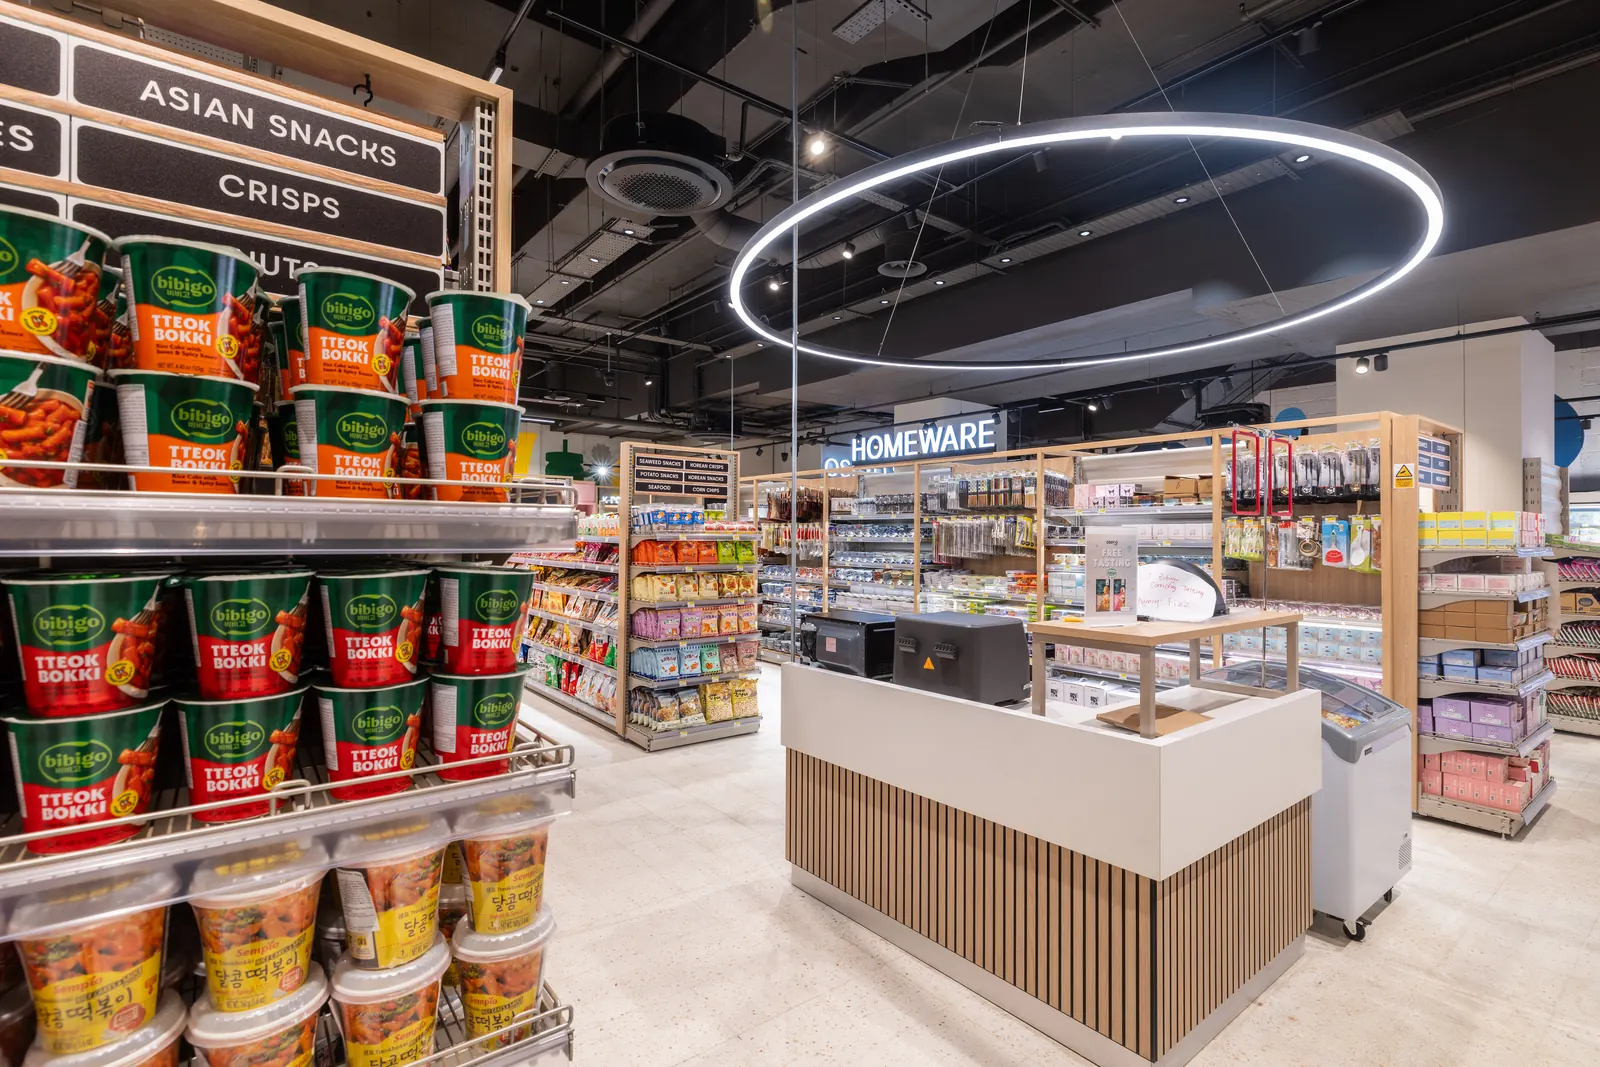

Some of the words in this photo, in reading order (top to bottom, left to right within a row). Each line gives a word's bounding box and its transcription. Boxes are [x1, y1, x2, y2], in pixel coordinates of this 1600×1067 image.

[140, 80, 254, 130] ASIAN
[268, 115, 397, 167] SNACKS
[219, 174, 340, 219] CRISPS
[158, 276, 212, 297] bibigo
[326, 302, 371, 320] bibigo
[152, 314, 211, 332] TTEOK
[154, 328, 212, 346] BOKKI
[320, 336, 368, 352] TTEOK
[322, 349, 368, 364] BOKKI
[470, 354, 510, 369] TTEOK
[472, 366, 510, 380] BOKKI
[179, 408, 229, 427] bibigo
[342, 421, 384, 438] bibigo
[467, 430, 504, 446] bibigo
[851, 419, 996, 461] HOMEWARE
[169, 446, 226, 461] TTEOK
[334, 455, 381, 468] TTEOK
[460, 462, 501, 474] TTEOK
[1102, 548, 1123, 558] FREE
[1092, 558, 1131, 568] TASTING
[350, 604, 393, 617] bibigo
[481, 597, 516, 611] bibigo
[216, 608, 266, 624] bibigo
[39, 616, 99, 632] bibigo
[472, 628, 512, 639] TTEOK
[211, 643, 265, 656] TTEOK
[345, 636, 392, 648] TTEOK
[472, 639, 511, 649] BOKKI
[347, 647, 392, 660] BOKKI
[35, 654, 99, 669] TTEOK
[213, 655, 266, 669] BOKKI
[38, 668, 101, 683] BOKKI
[480, 702, 512, 715] bibigo
[358, 715, 400, 729] bibigo
[210, 731, 261, 746] bibigo
[471, 730, 508, 743] TTEOK
[351, 746, 398, 760] TTEOK
[471, 740, 507, 754] BOKKI
[45, 752, 107, 768] bibigo
[353, 756, 398, 773] BOKKI
[204, 764, 259, 779] TTEOK
[206, 776, 259, 792] BOKKI
[39, 788, 105, 806] TTEOK
[42, 800, 106, 821] BOKKI
[215, 951, 298, 988] 달콤떡볶이
